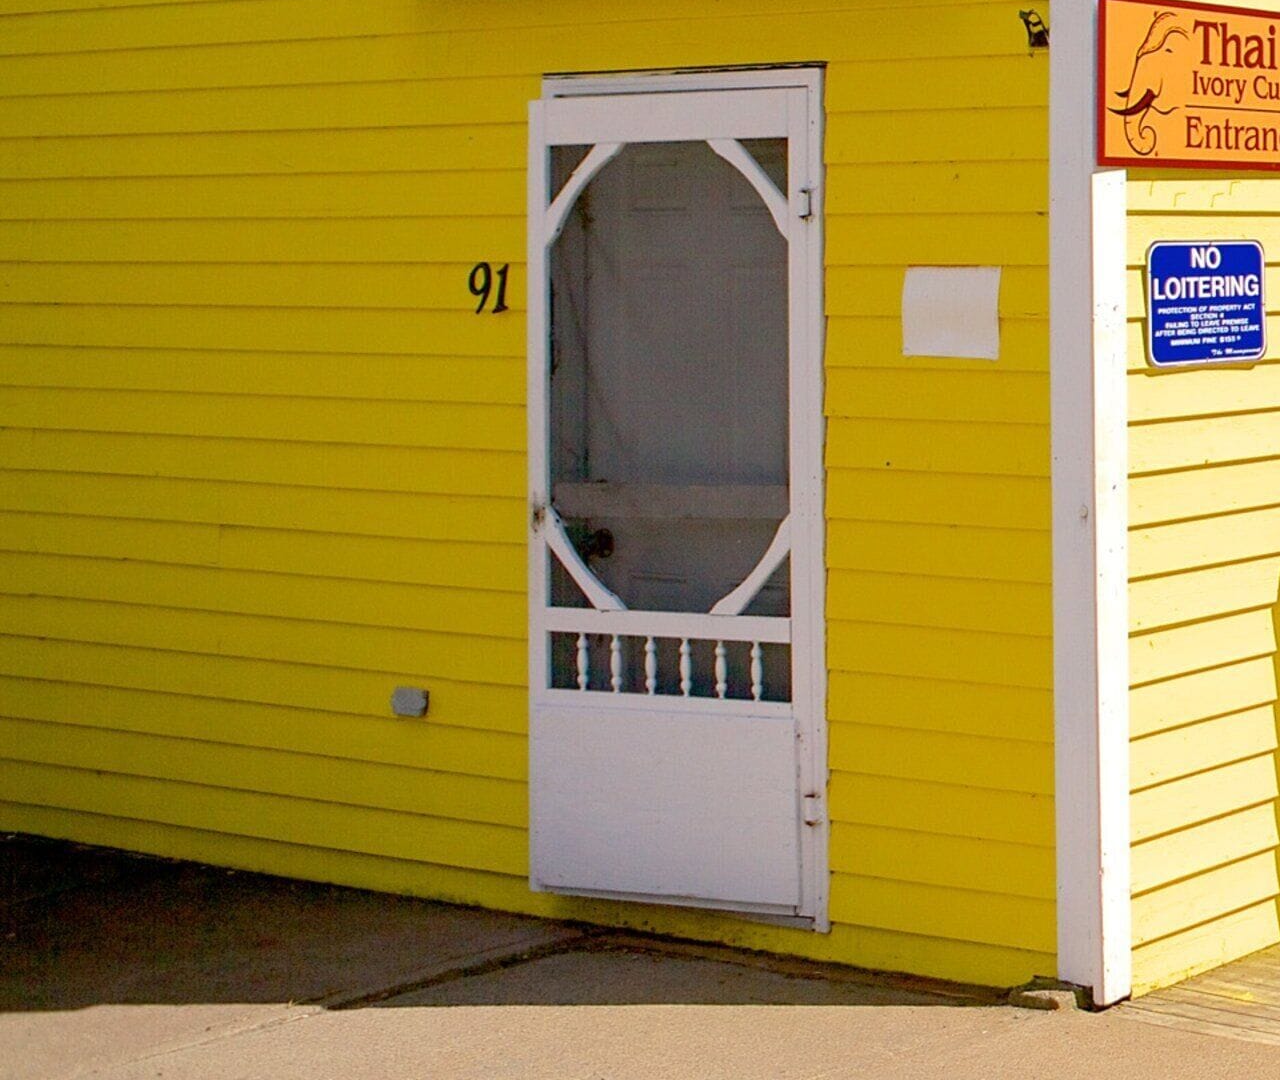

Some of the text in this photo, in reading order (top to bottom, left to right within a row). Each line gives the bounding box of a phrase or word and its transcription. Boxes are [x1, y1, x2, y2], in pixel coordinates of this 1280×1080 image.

[1193, 19, 1278, 70] Thai
[1192, 70, 1247, 104] Ivory
[1191, 247, 1221, 269] NO
[468, 261, 509, 315] 91
[1153, 274, 1260, 300] LOITERING
[1157, 306, 1197, 314] PROTECTION
[1209, 304, 1242, 312] PROPERTY
